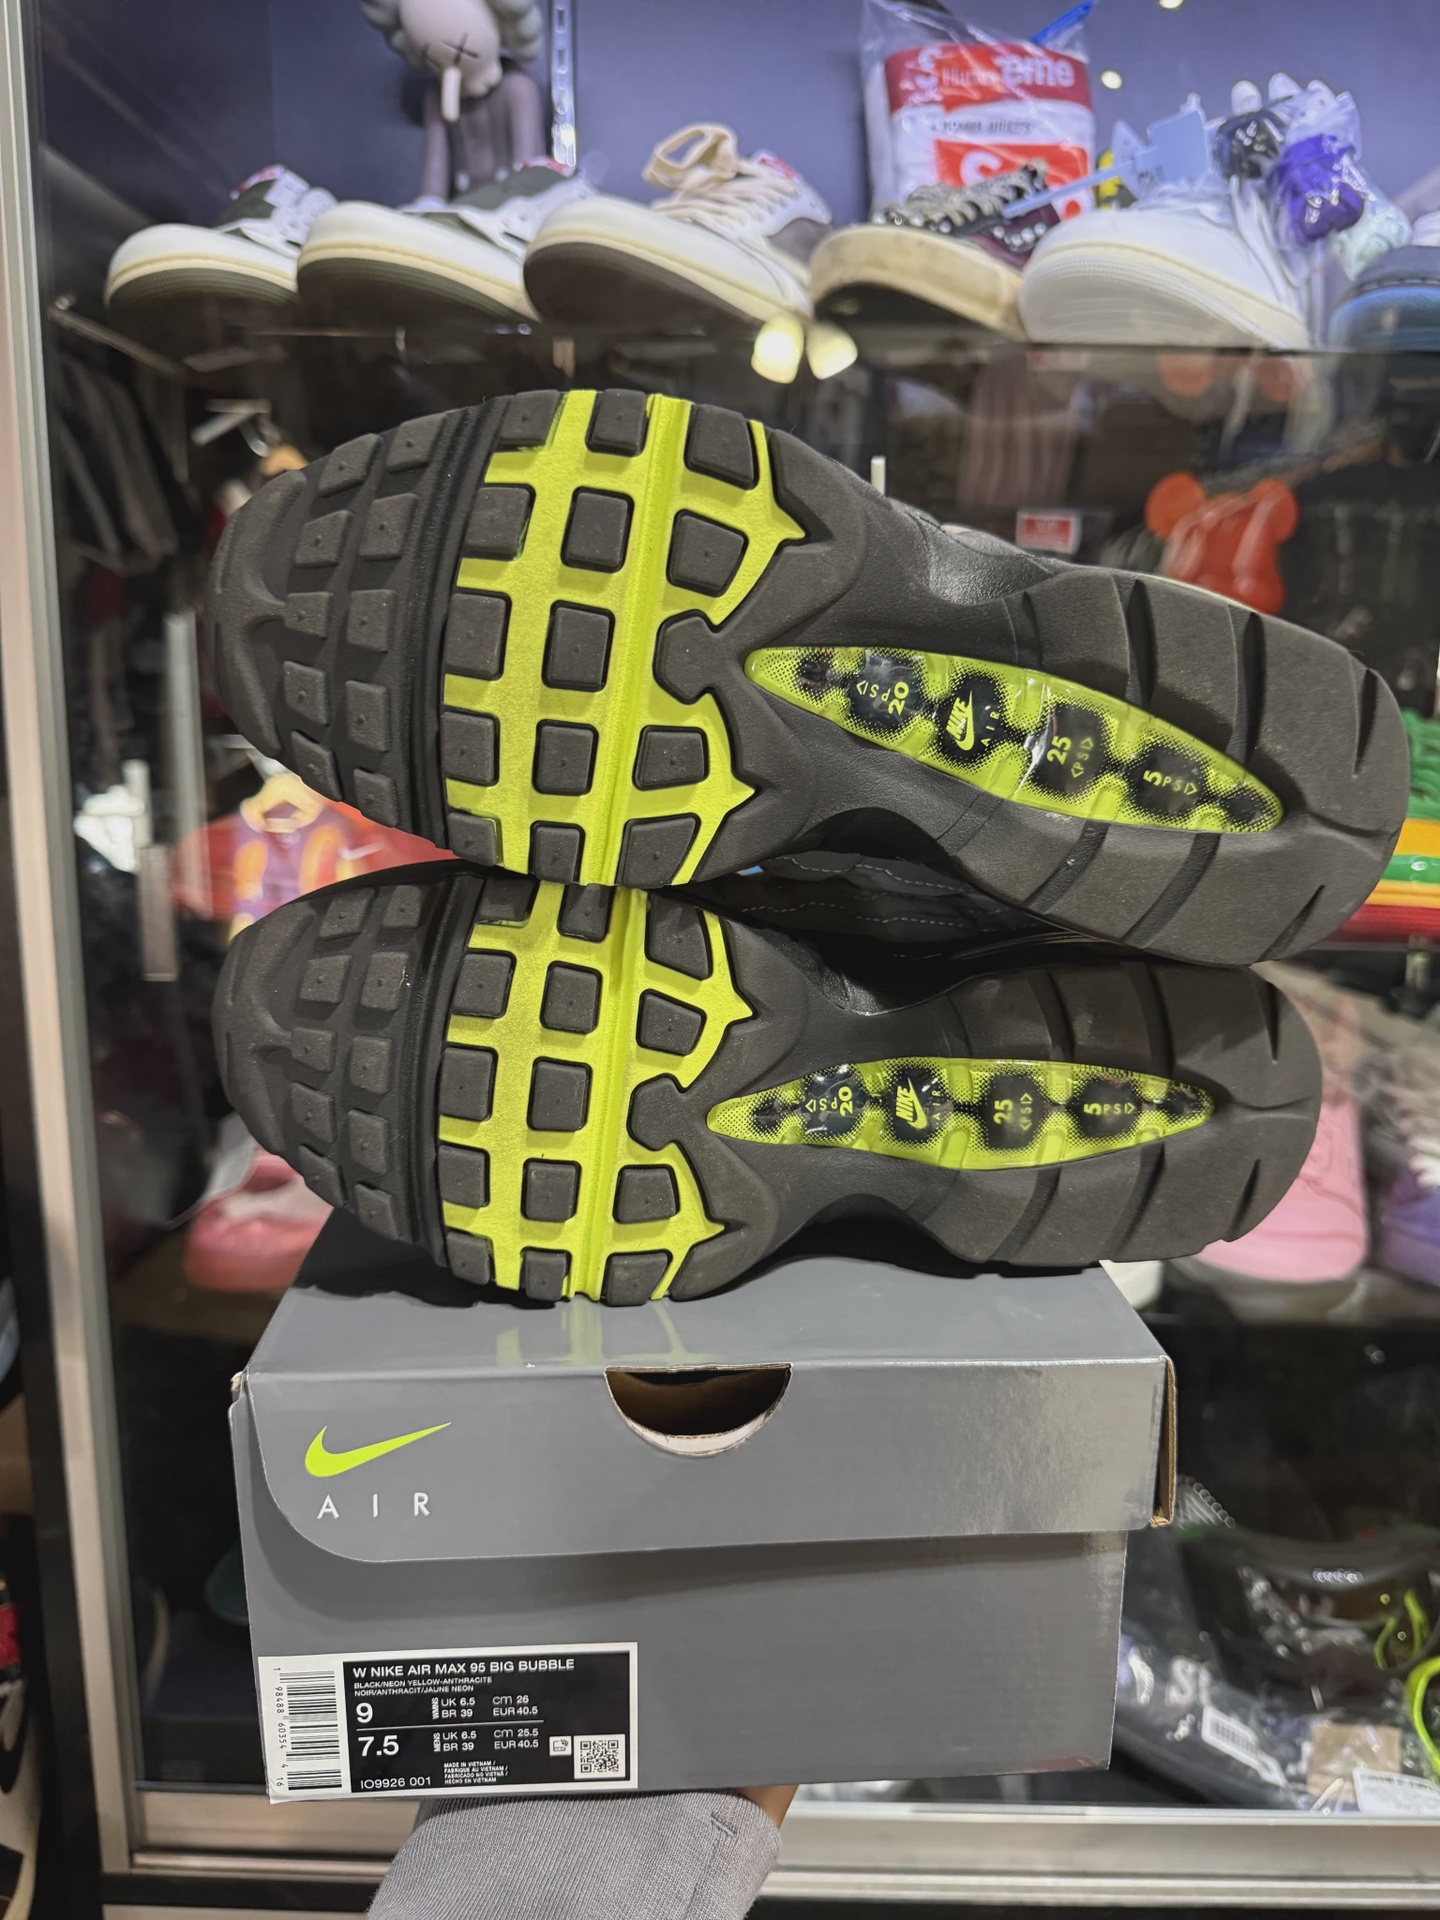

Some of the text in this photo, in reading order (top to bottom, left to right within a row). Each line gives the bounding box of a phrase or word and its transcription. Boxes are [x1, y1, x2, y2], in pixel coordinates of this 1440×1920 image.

[888, 682, 909, 715] 20
[946, 697, 968, 741] NIKE
[981, 711, 1000, 747] AIR
[1046, 736, 1072, 765] 25
[1143, 770, 1162, 786] 5
[838, 1087, 853, 1117] 20
[896, 1086, 915, 1122] NIKE
[931, 1090, 942, 1121] AIR
[1084, 1103, 1101, 1116] 5
[993, 1099, 1013, 1125] 25
[317, 1492, 430, 1519] AIR
[353, 1658, 575, 1678] W NIKE AIR MAX 95 BIG BUBBLE
[354, 1680, 405, 1689] BLACK/NEON
[354, 1685, 449, 1697] NOIR/ANTHRACIT/JAUNE
[275, 1686, 284, 1713] 98488
[441, 1697, 476, 1707] UK 6.5
[516, 1695, 529, 1704] 26
[356, 1702, 374, 1723] 9
[441, 1708, 473, 1718] BR 39
[493, 1706, 538, 1717] EUR 40.5
[278, 1722, 287, 1749] 60354
[442, 1730, 477, 1740] UK 6.5
[517, 1728, 539, 1737] 25.5
[357, 1734, 399, 1757] 7.5
[443, 1742, 475, 1752] BR 39
[494, 1739, 539, 1750] EUR 40.5
[276, 1777, 284, 1786] 16
[410, 1776, 431, 1786] 001
